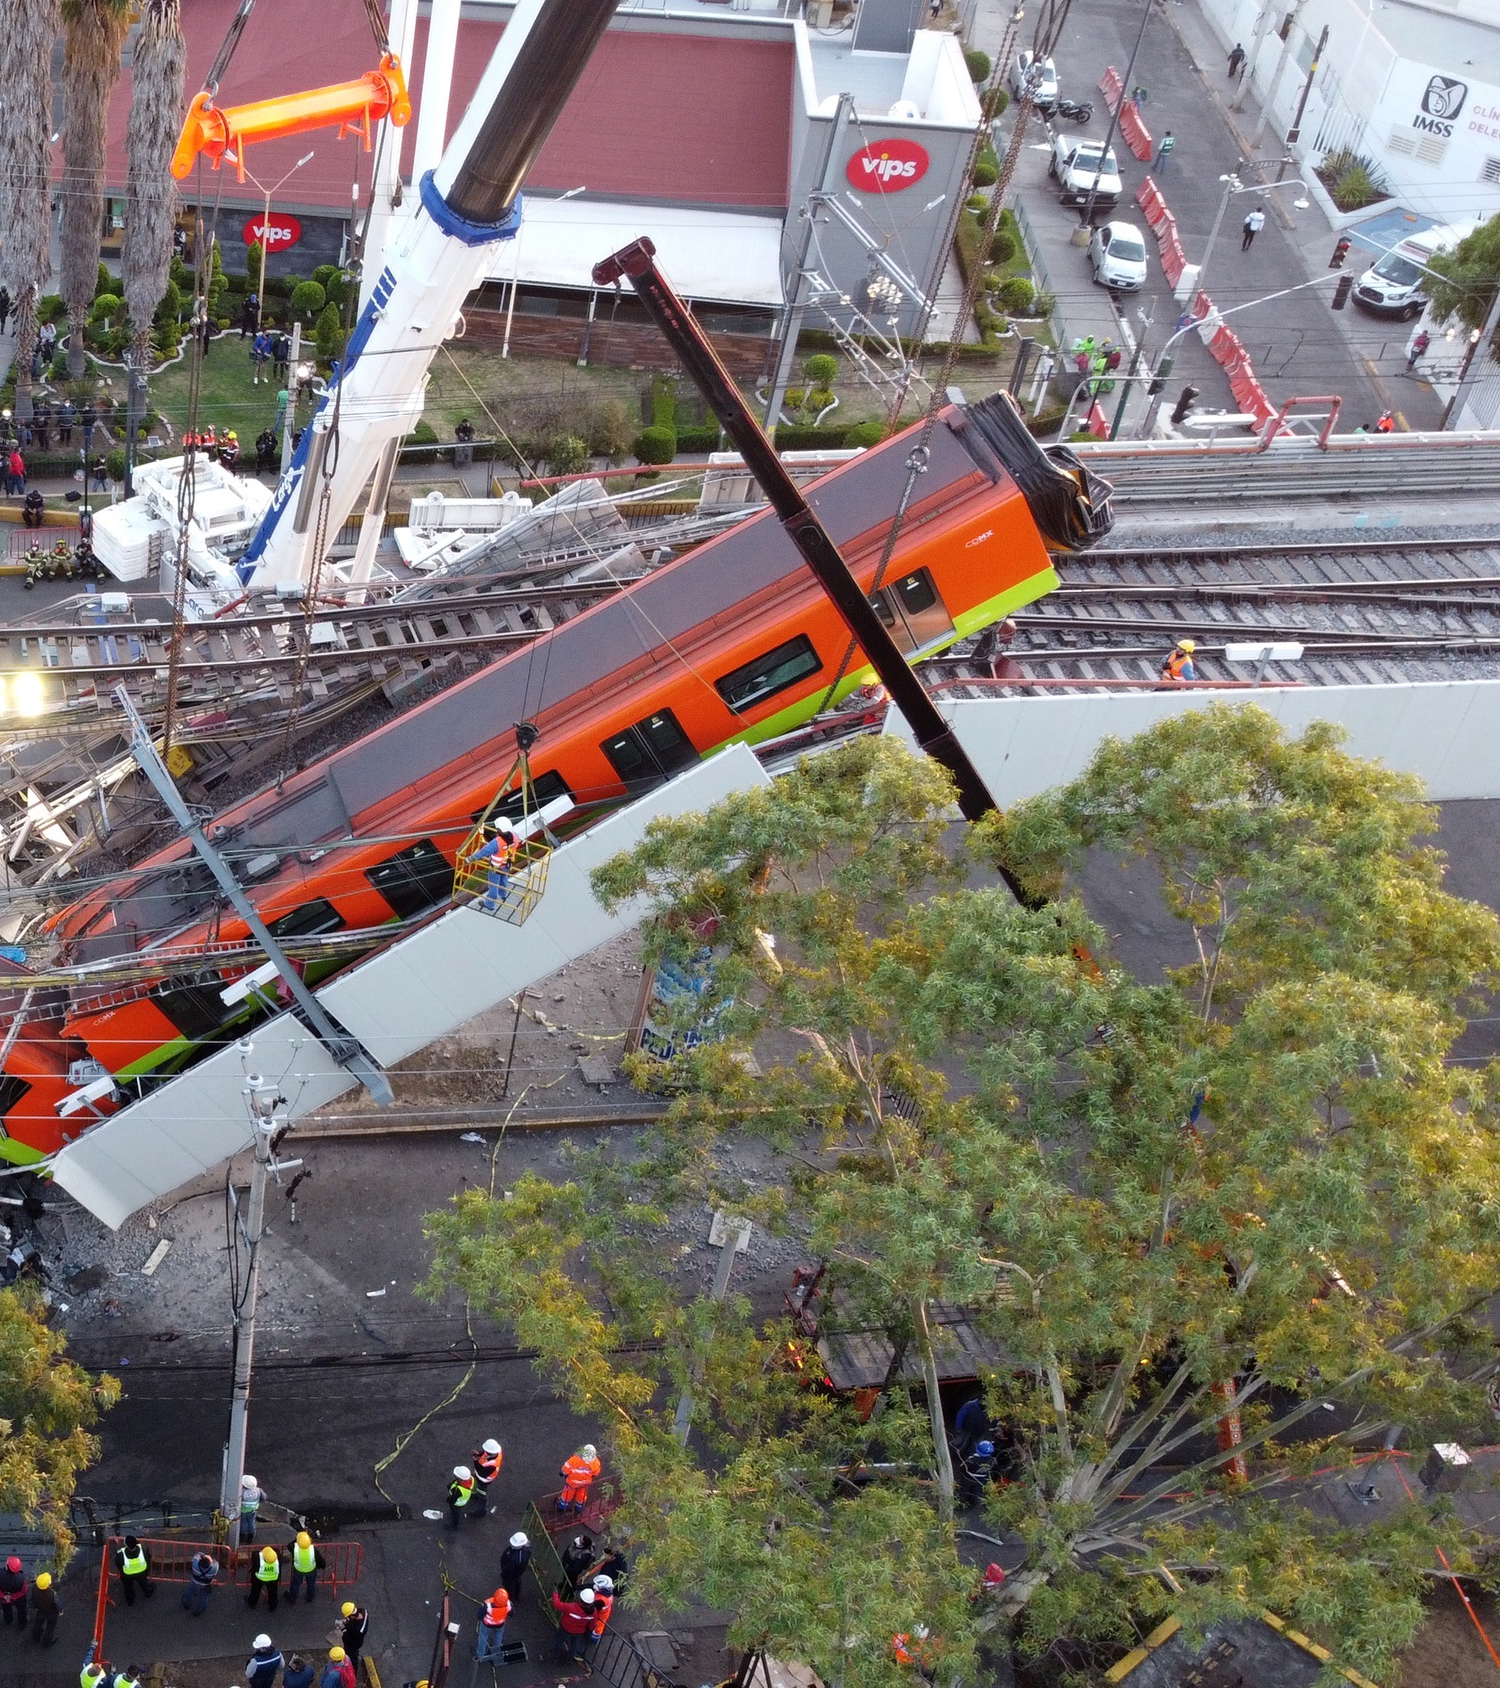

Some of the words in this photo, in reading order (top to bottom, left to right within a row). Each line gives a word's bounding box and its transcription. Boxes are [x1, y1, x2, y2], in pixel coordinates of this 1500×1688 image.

[1412, 114, 1454, 138] IMSS
[1468, 120, 1500, 139] DELE
[862, 153, 917, 182] vips
[252, 222, 292, 244] vips
[965, 529, 994, 549] CDMX
